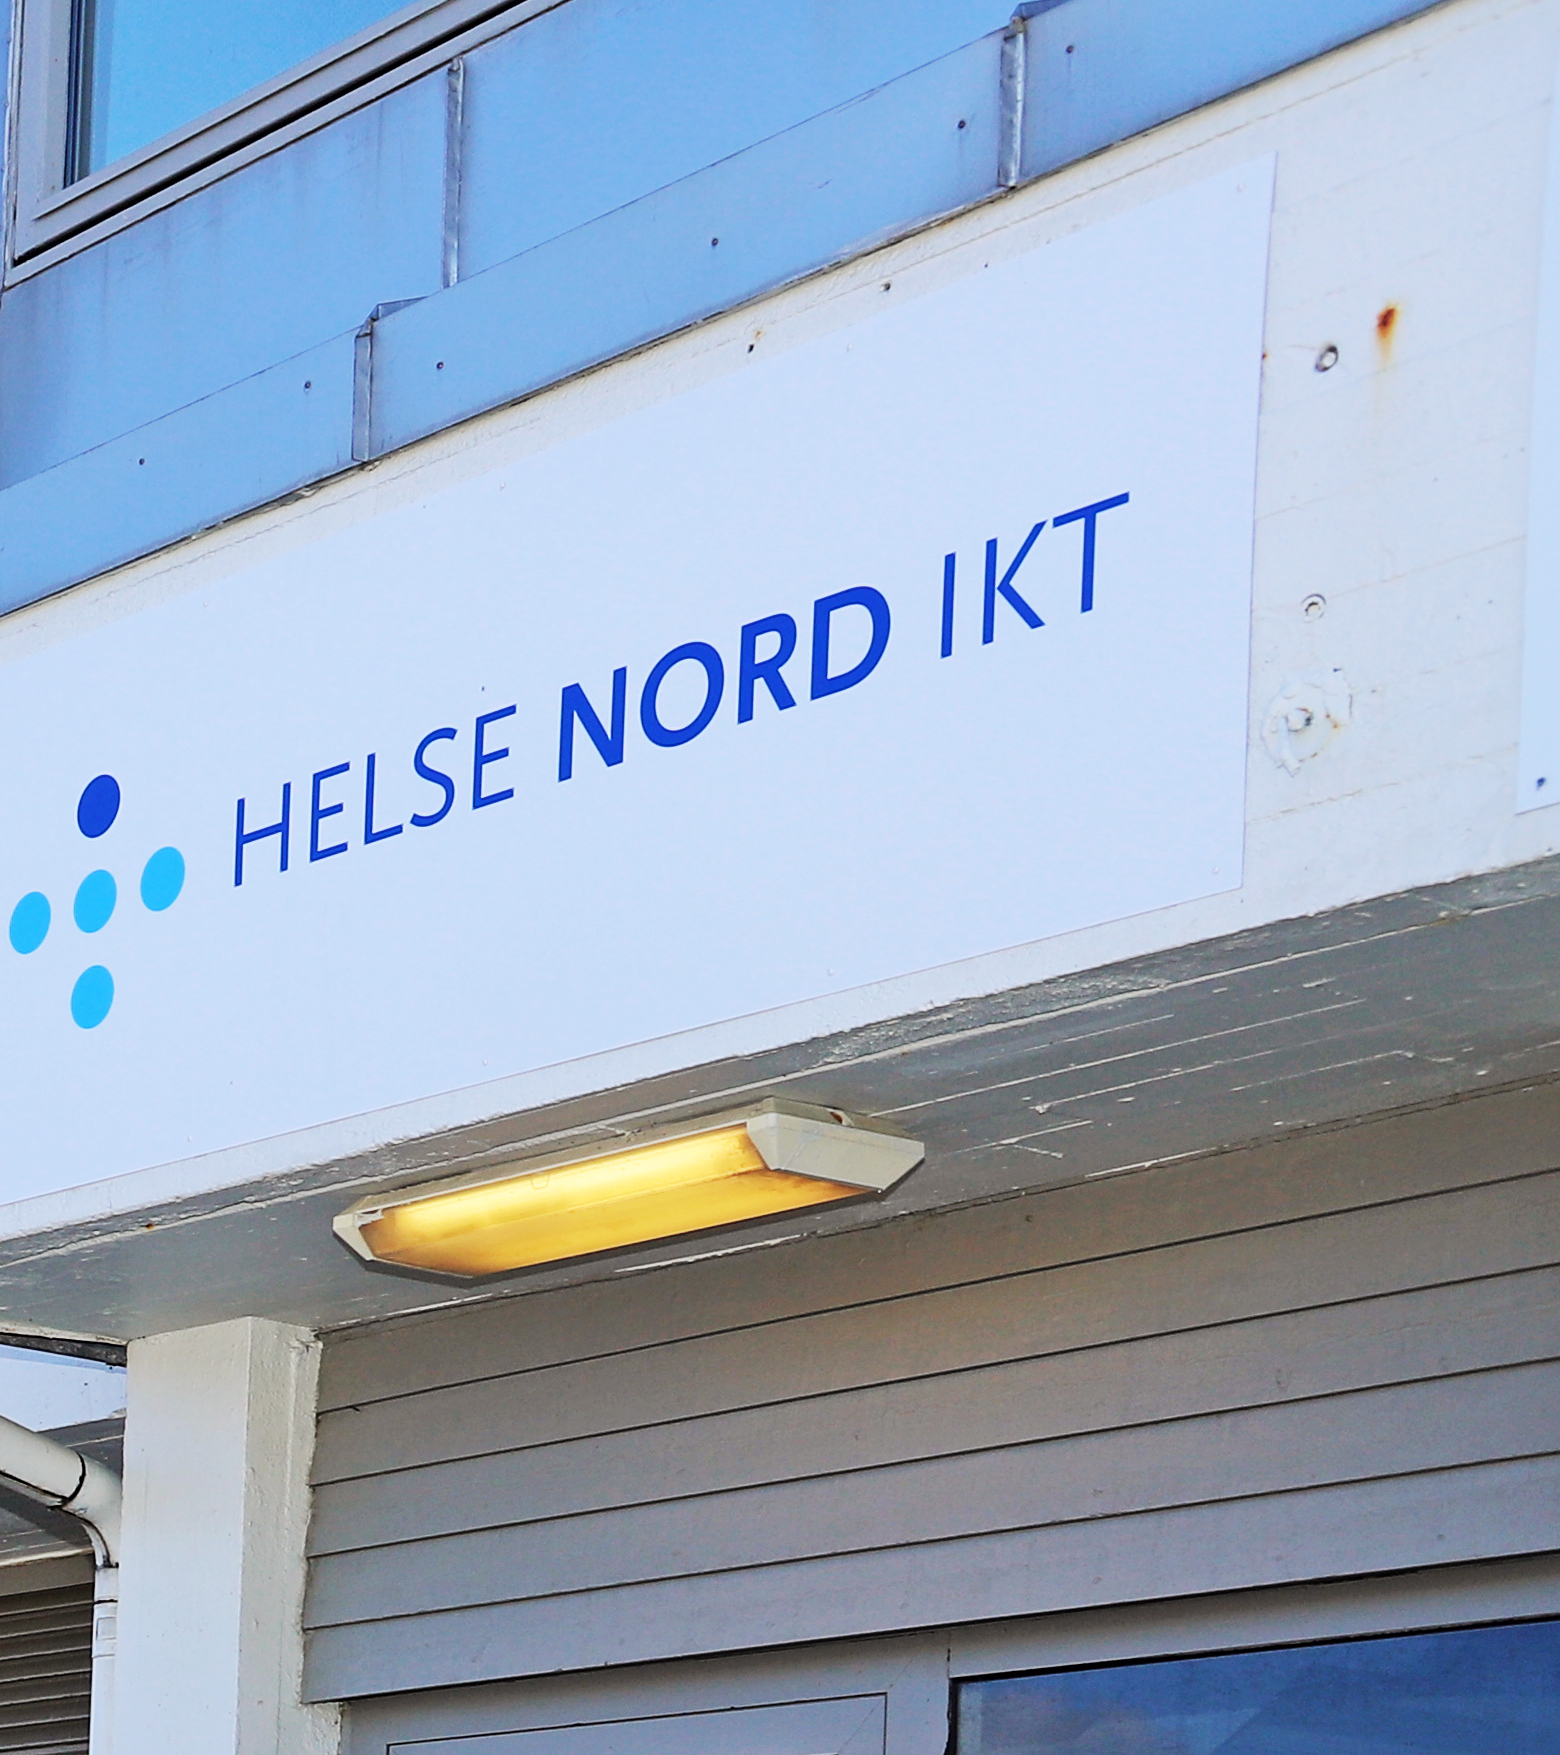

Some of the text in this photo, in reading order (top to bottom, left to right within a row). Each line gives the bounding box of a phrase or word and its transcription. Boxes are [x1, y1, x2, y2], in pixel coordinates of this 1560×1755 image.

[233, 491, 1130, 888] HELSE NORD IKT
